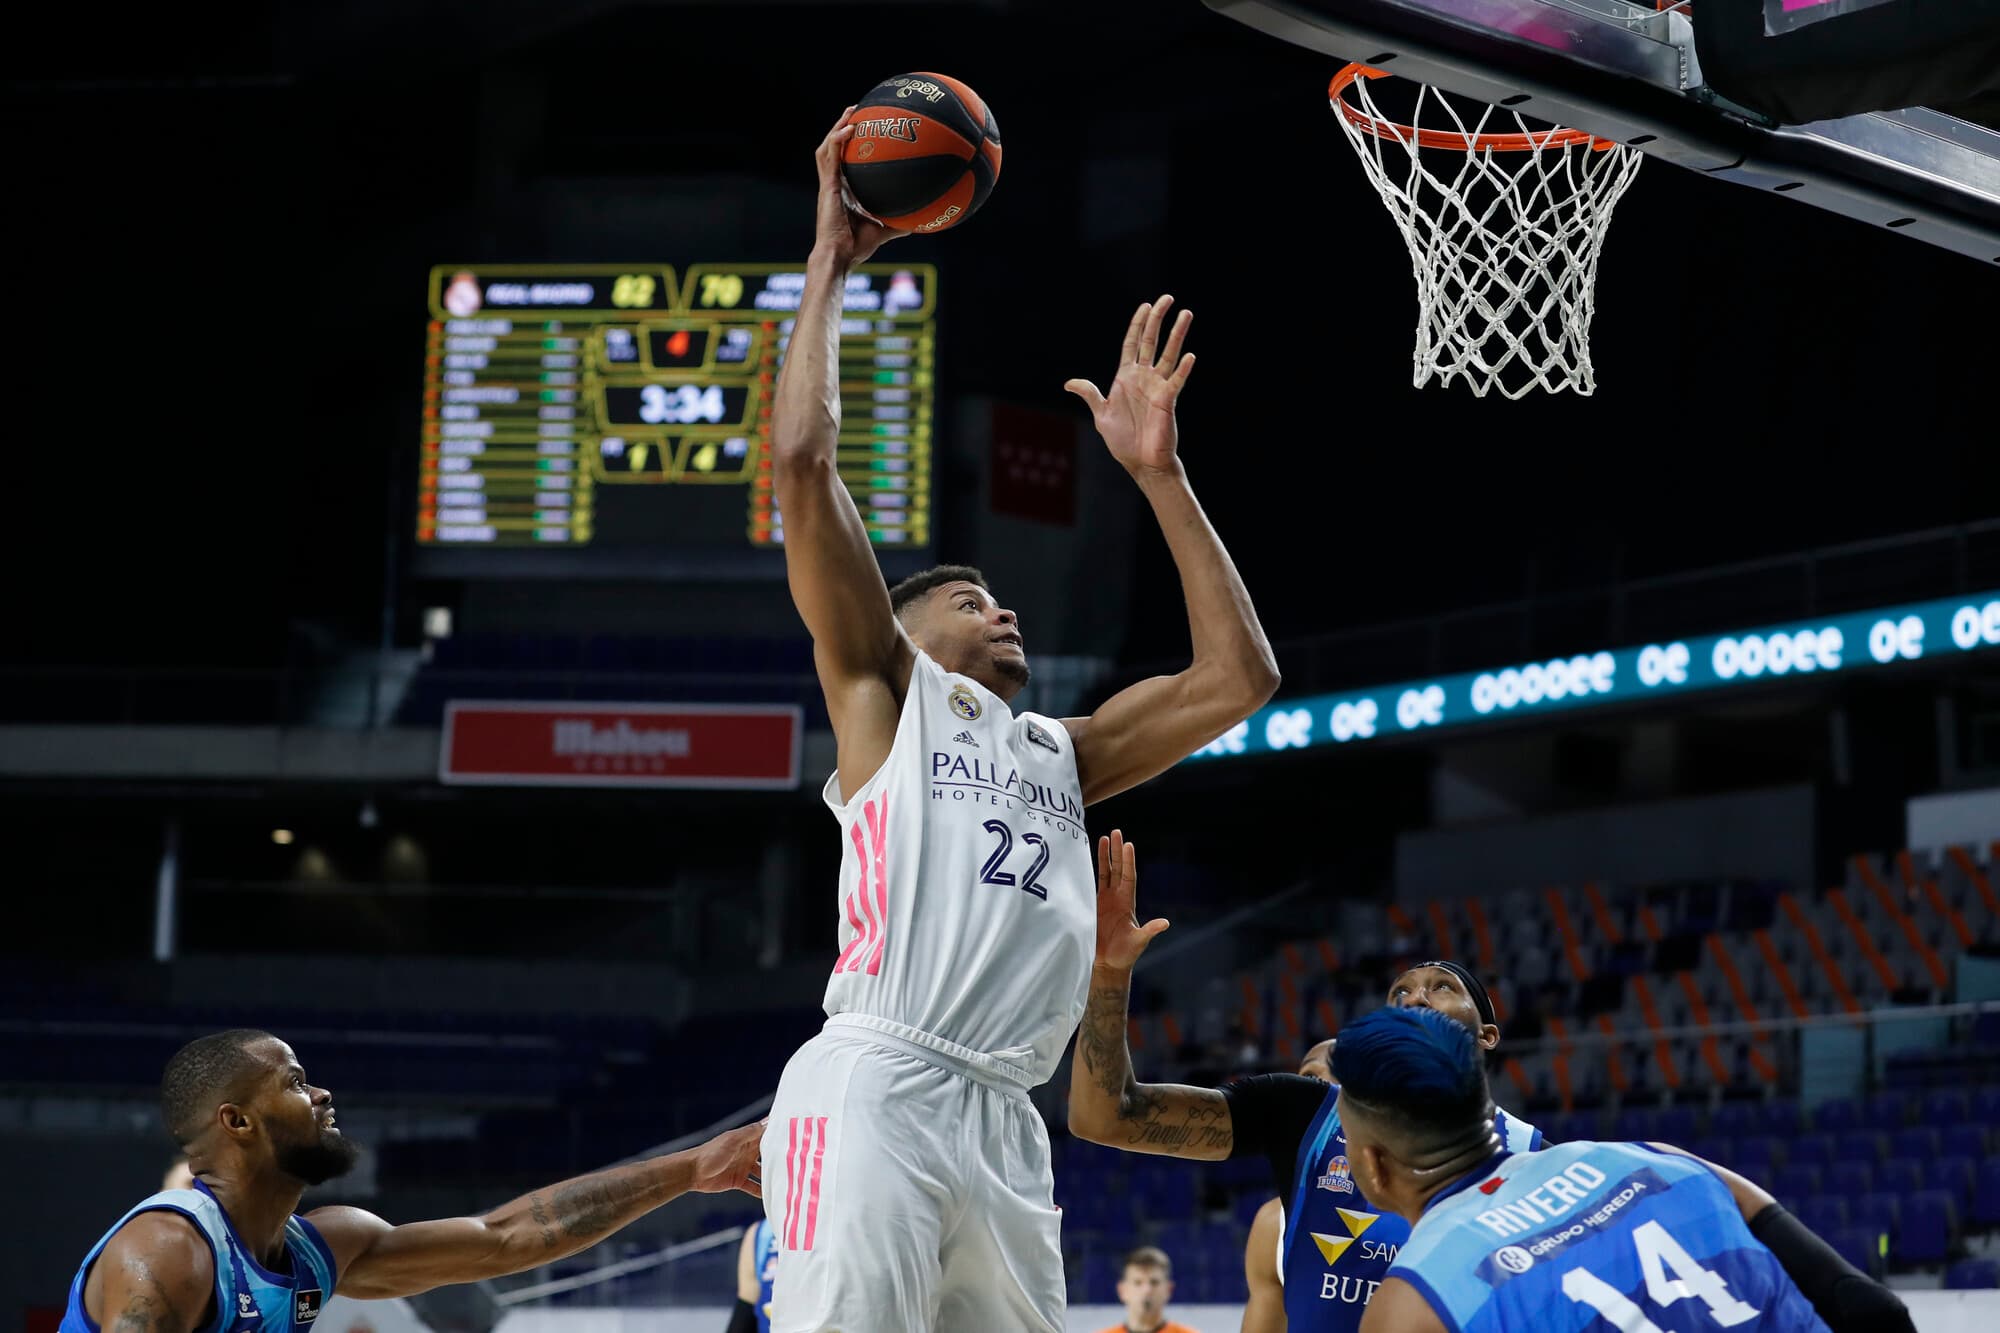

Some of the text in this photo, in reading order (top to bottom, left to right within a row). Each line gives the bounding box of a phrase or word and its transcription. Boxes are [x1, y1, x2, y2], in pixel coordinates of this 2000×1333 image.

[640, 384, 725, 423] 3:34
[1266, 708, 1312, 750] oe
[1331, 698, 1378, 742] oe
[1397, 684, 1445, 729] oe
[1637, 642, 1690, 686] oe
[1869, 615, 1924, 663] oe
[932, 789, 1013, 809] HOTEL
[979, 819, 1051, 901] 22
[1475, 1161, 1607, 1237] RIVERO
[1529, 1181, 1648, 1256] GRUPO HEREDA
[1562, 1219, 1761, 1333] 14
